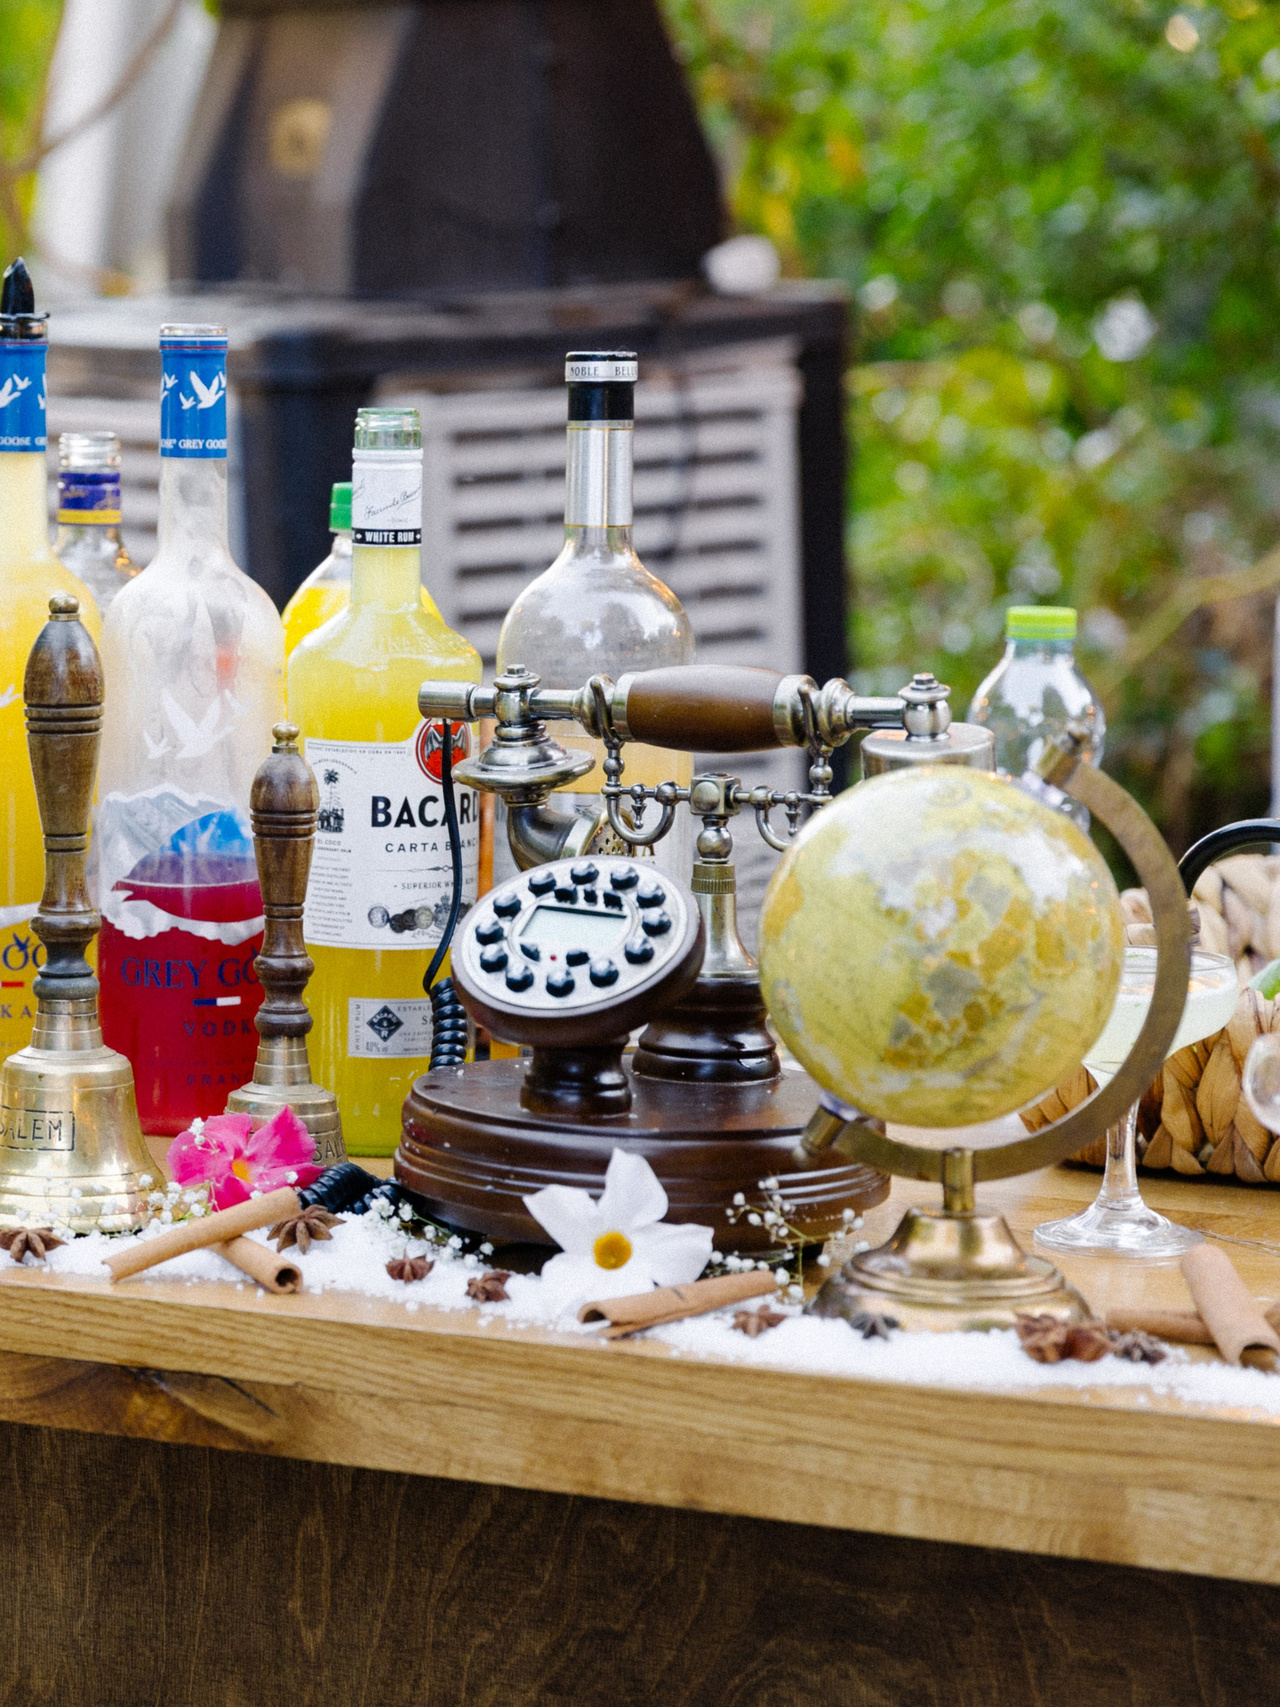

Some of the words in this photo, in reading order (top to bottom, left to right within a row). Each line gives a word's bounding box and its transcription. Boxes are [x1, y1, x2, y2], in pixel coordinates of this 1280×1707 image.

[569, 366, 600, 377] NOBLE
[178, 438, 205, 449] GREY
[364, 531, 396, 544] WHITE
[397, 531, 415, 543] RUM
[385, 842, 439, 853] CARTA
[401, 881, 443, 890] SUPERIOR
[121, 957, 208, 989] GREY
